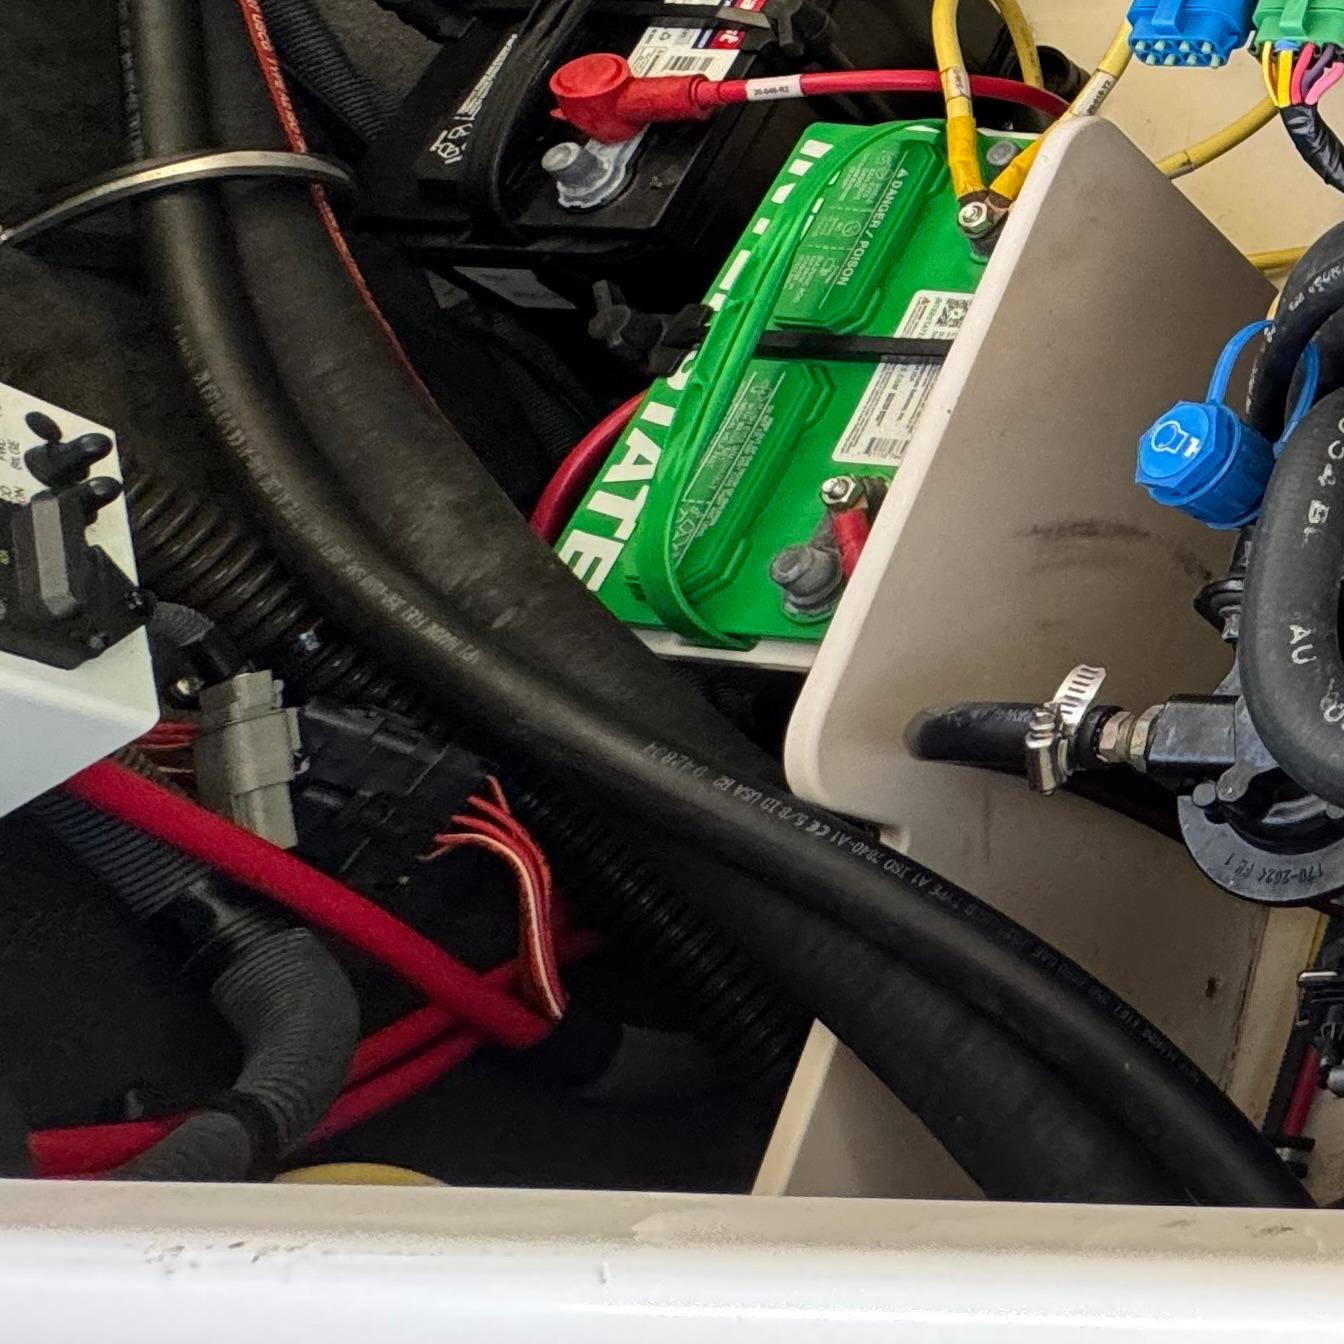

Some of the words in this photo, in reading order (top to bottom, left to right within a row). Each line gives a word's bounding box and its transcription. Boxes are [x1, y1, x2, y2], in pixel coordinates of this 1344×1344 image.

[870, 181, 903, 228] DANGER
[838, 240, 870, 286] POISON
[1289, 625, 1317, 664] AU
[732, 781, 763, 807] USA
